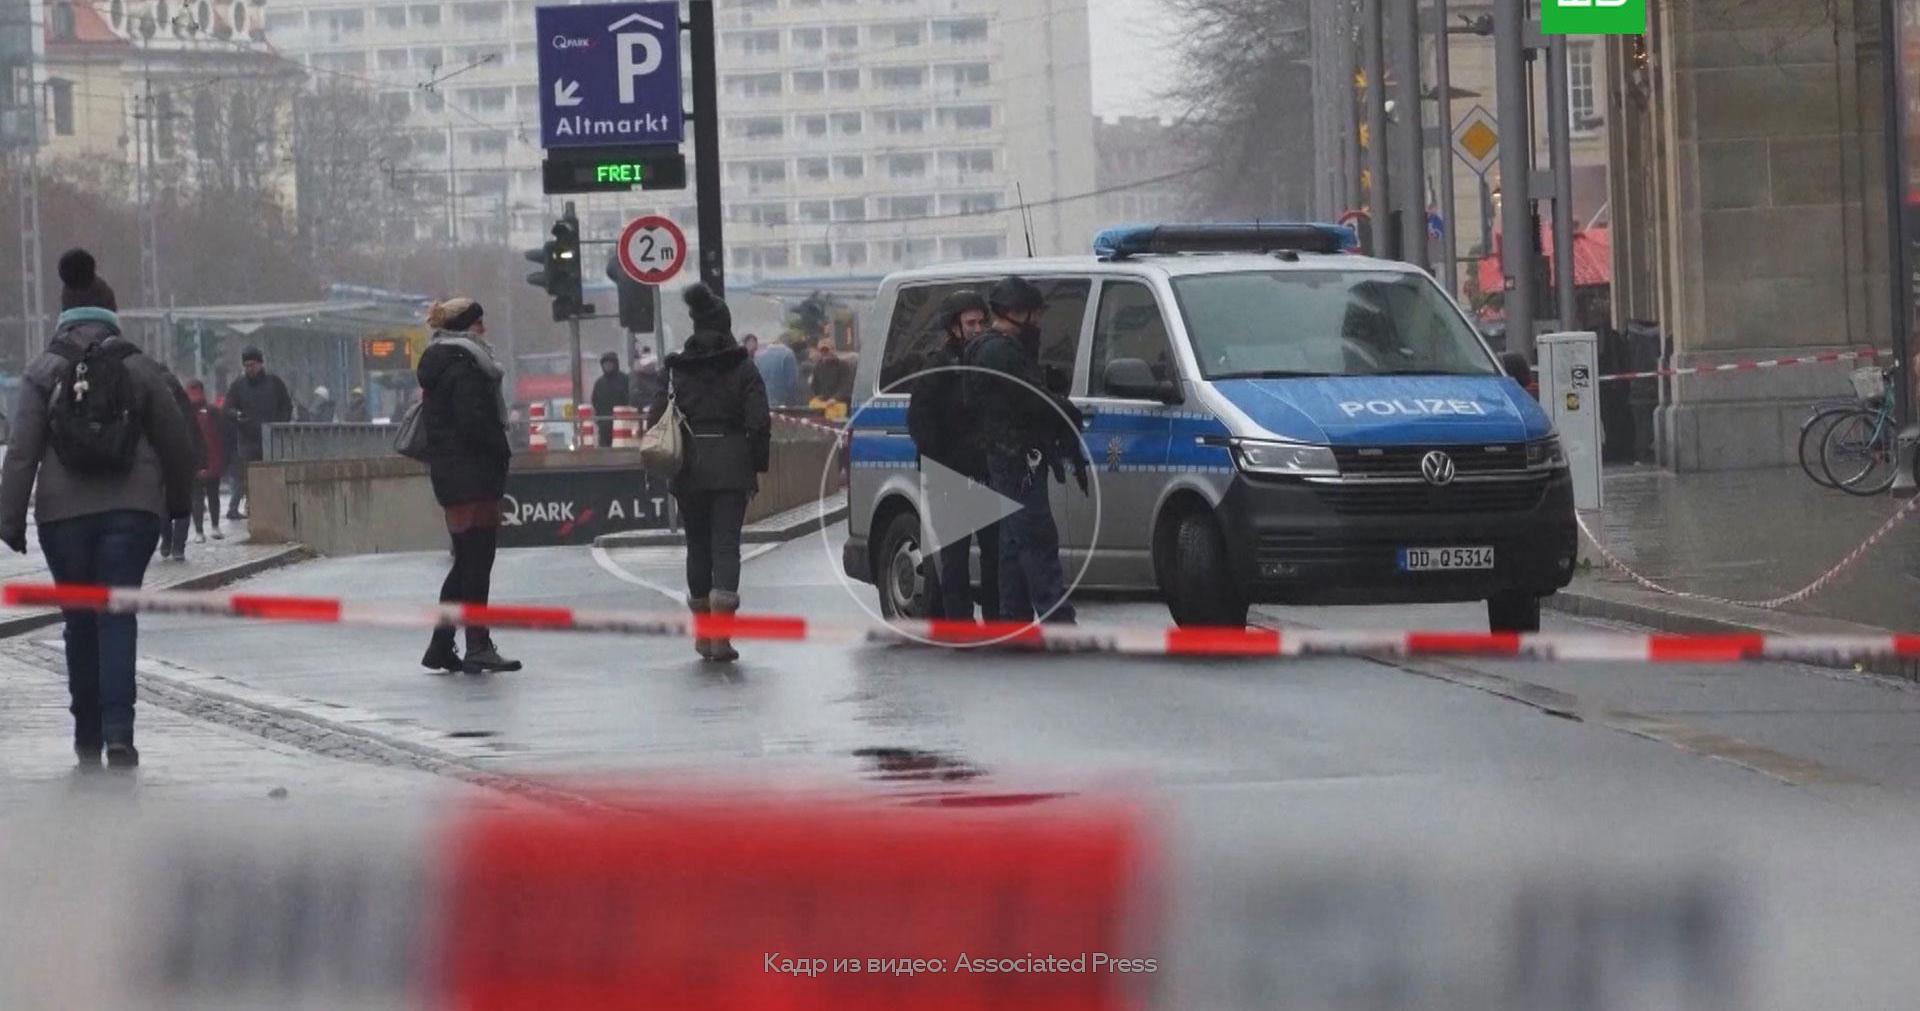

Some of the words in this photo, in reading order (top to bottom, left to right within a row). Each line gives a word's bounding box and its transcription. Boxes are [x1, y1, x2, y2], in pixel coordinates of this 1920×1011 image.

[616, 32, 663, 104] P
[556, 113, 669, 136] Altmarkt
[597, 165, 641, 182] FREI
[639, 235, 655, 262] 2
[660, 247, 674, 260] m
[1339, 399, 1487, 417] POLIZEI
[1409, 551, 1429, 567] DD
[1454, 549, 1492, 567] 5314
